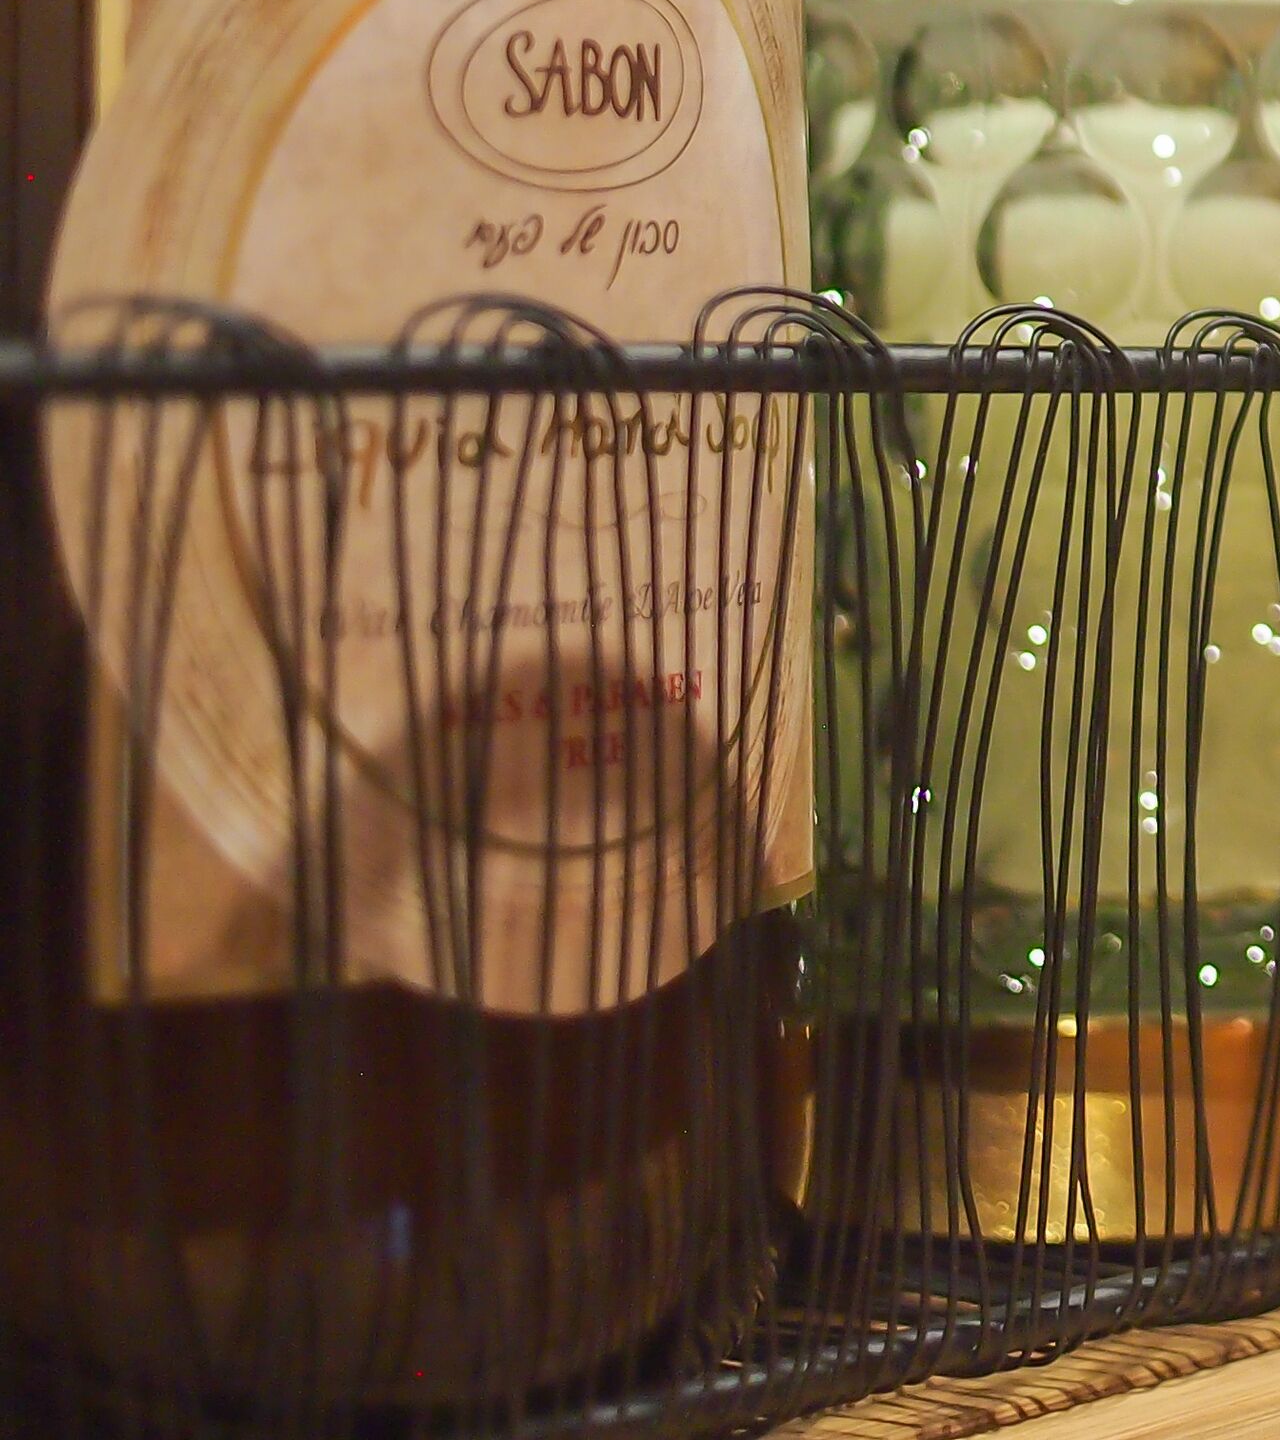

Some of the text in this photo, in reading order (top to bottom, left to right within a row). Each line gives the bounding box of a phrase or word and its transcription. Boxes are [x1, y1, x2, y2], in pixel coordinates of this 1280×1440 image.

[503, 30, 662, 122] SABON
[664, 580, 714, 616] Aoe
[722, 570, 762, 608] Vea
